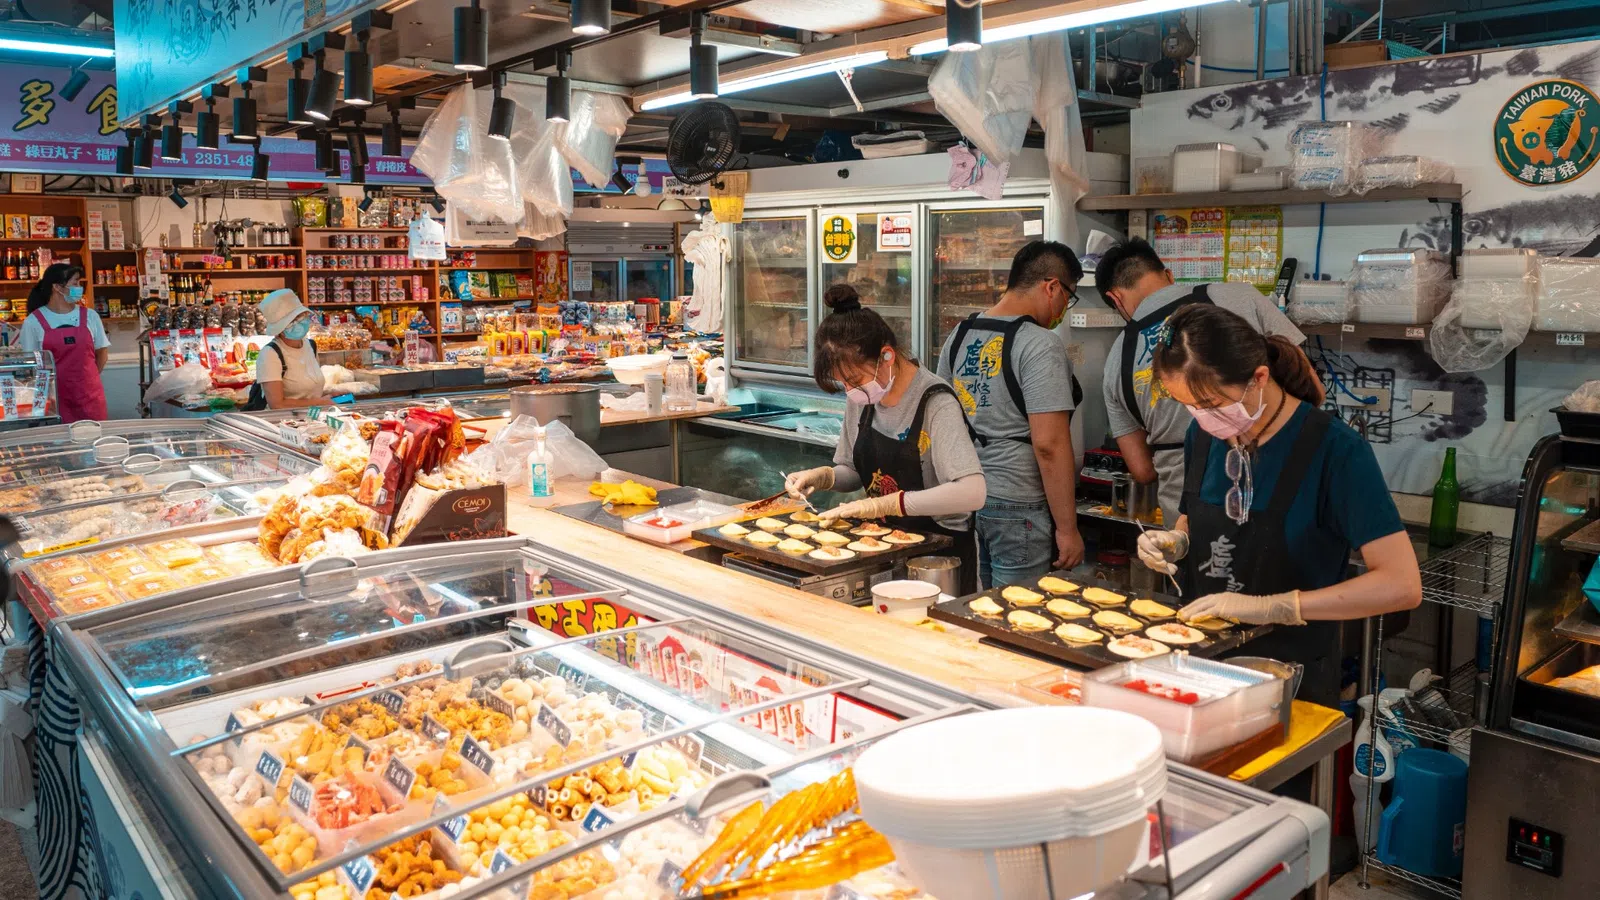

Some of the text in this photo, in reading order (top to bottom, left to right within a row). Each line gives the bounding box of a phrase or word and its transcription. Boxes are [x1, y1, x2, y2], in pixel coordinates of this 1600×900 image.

[1503, 84, 1589, 120] TAIWAN PORK
[195, 152, 271, 167] 2351-48
[1519, 160, 1578, 183] 臺灣豬
[1191, 221, 1207, 229] 2022
[825, 232, 850, 247] 台灣豬
